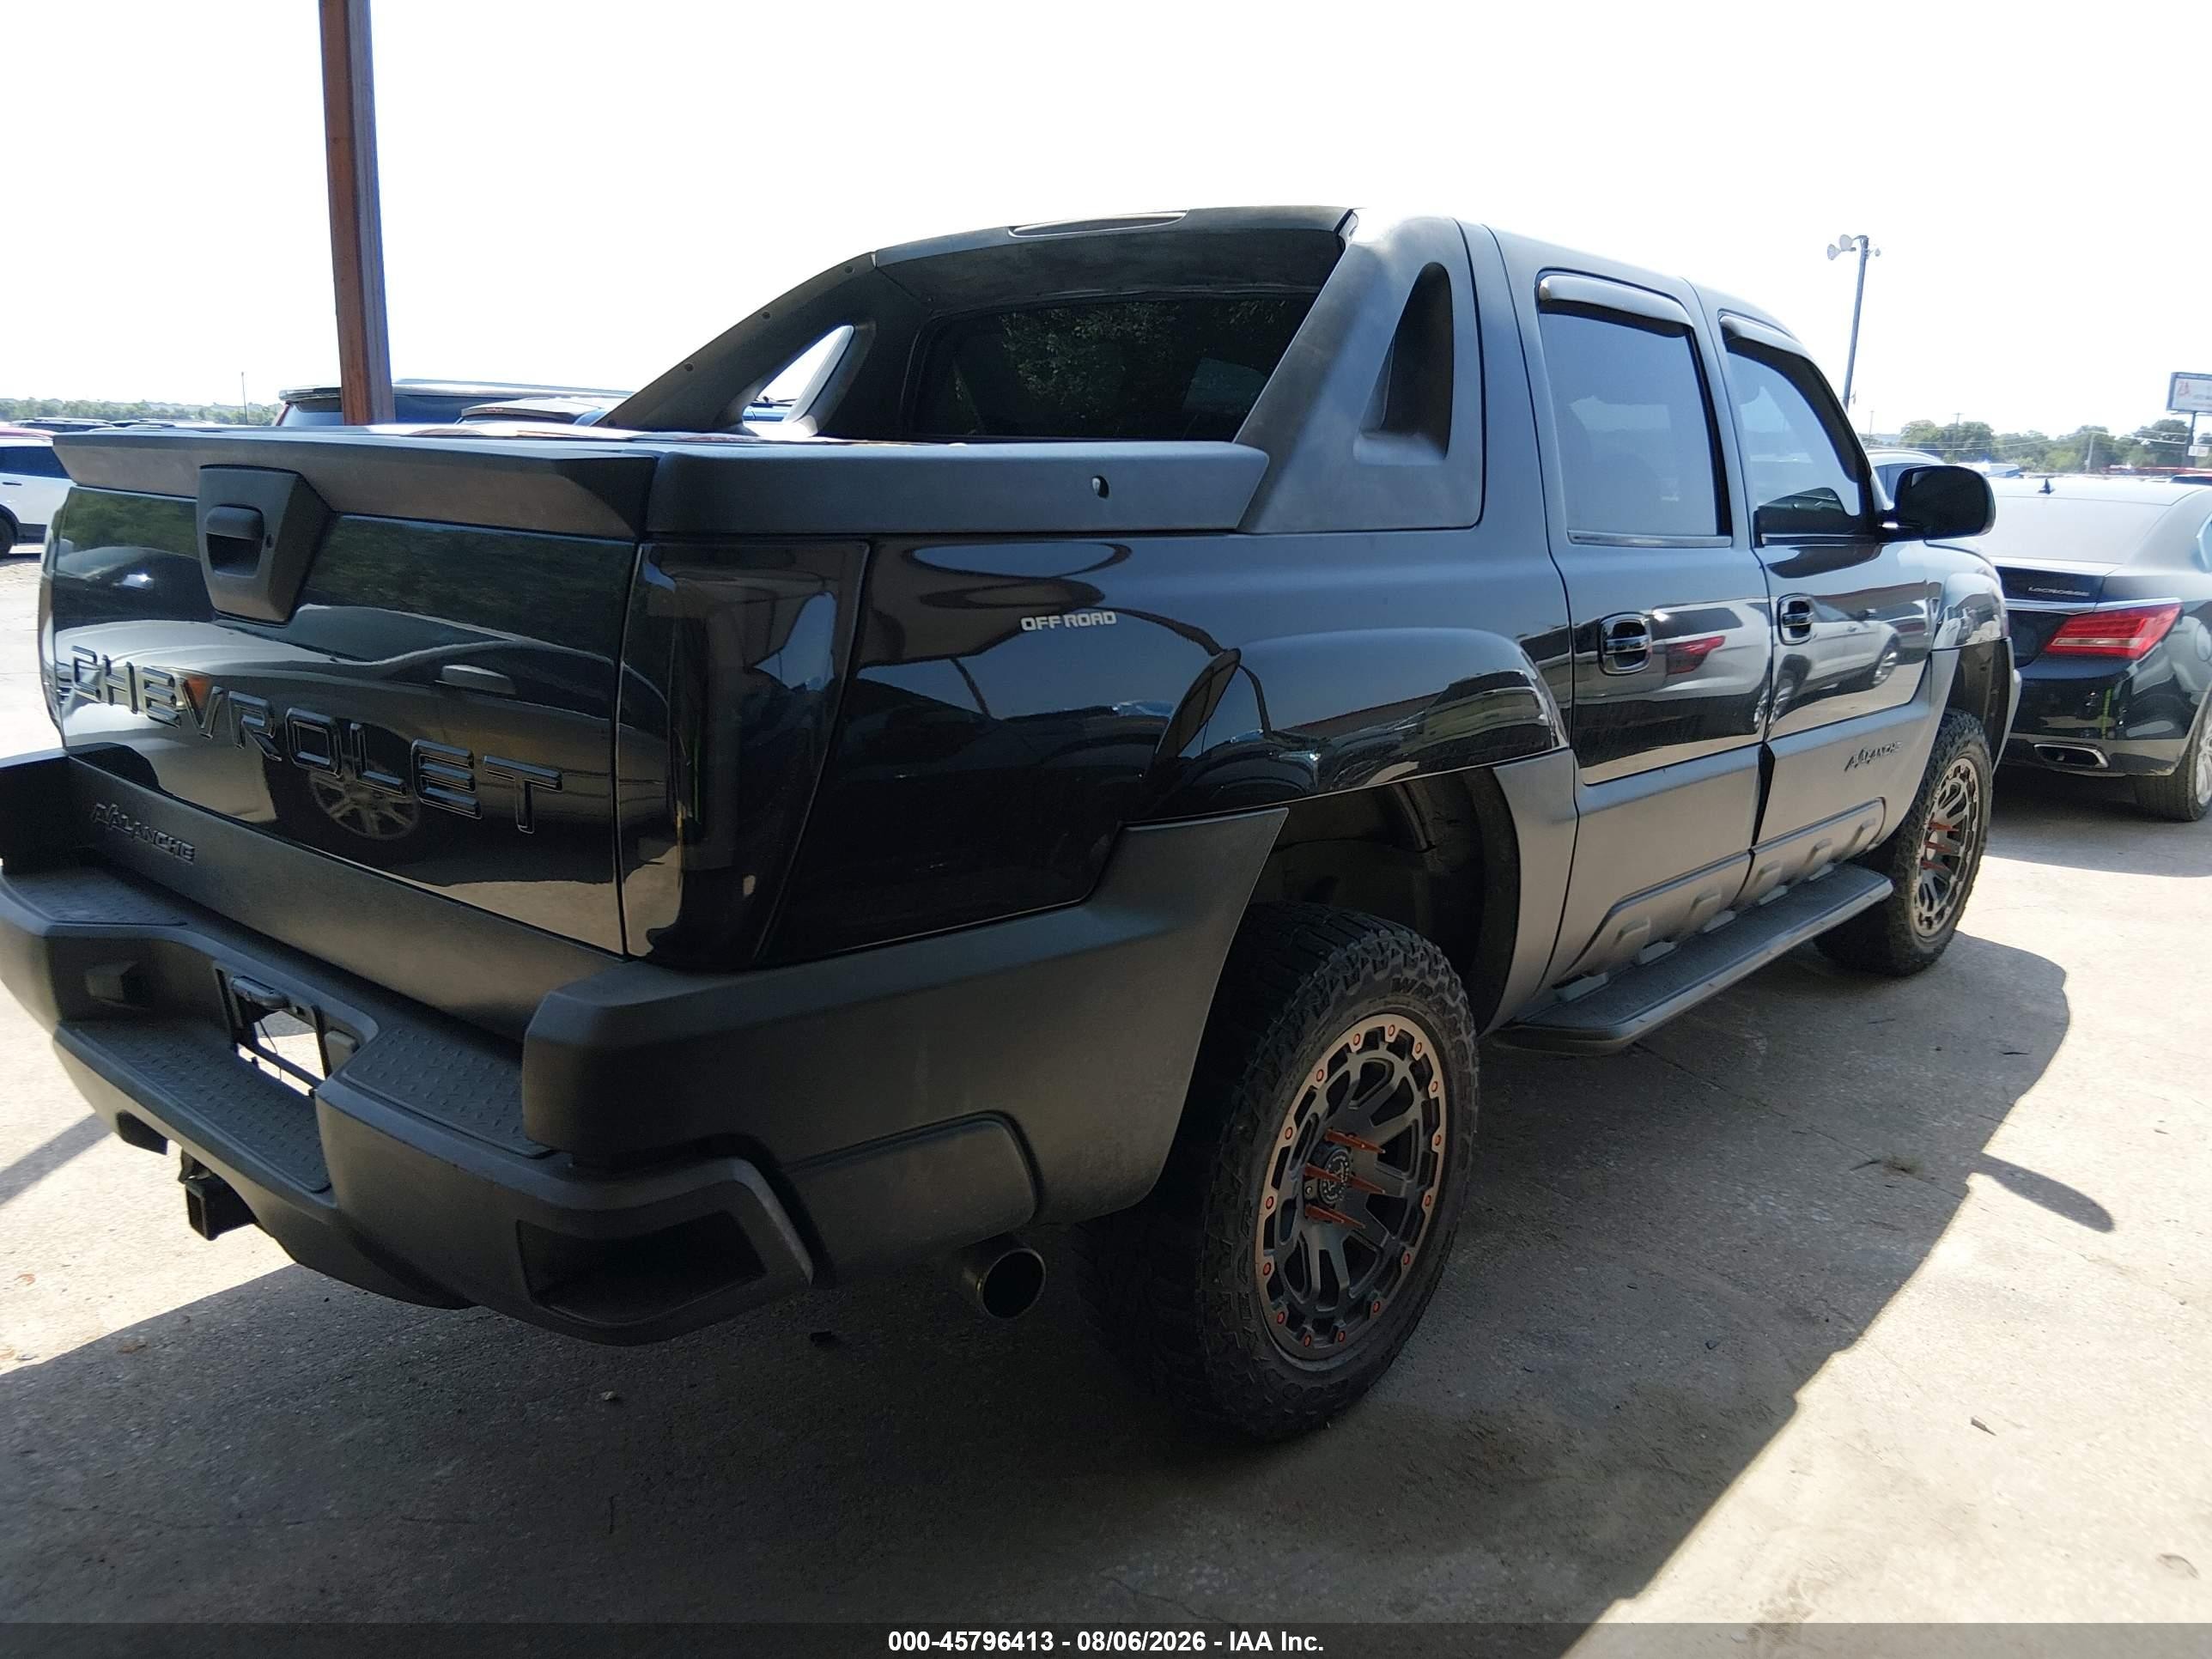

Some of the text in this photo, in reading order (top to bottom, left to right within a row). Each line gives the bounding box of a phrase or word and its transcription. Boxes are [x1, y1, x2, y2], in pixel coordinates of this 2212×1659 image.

[1020, 611, 1117, 631] OFF ROAD
[71, 645, 563, 835] CHEVROLET
[91, 803, 196, 866] AVALANCHE
